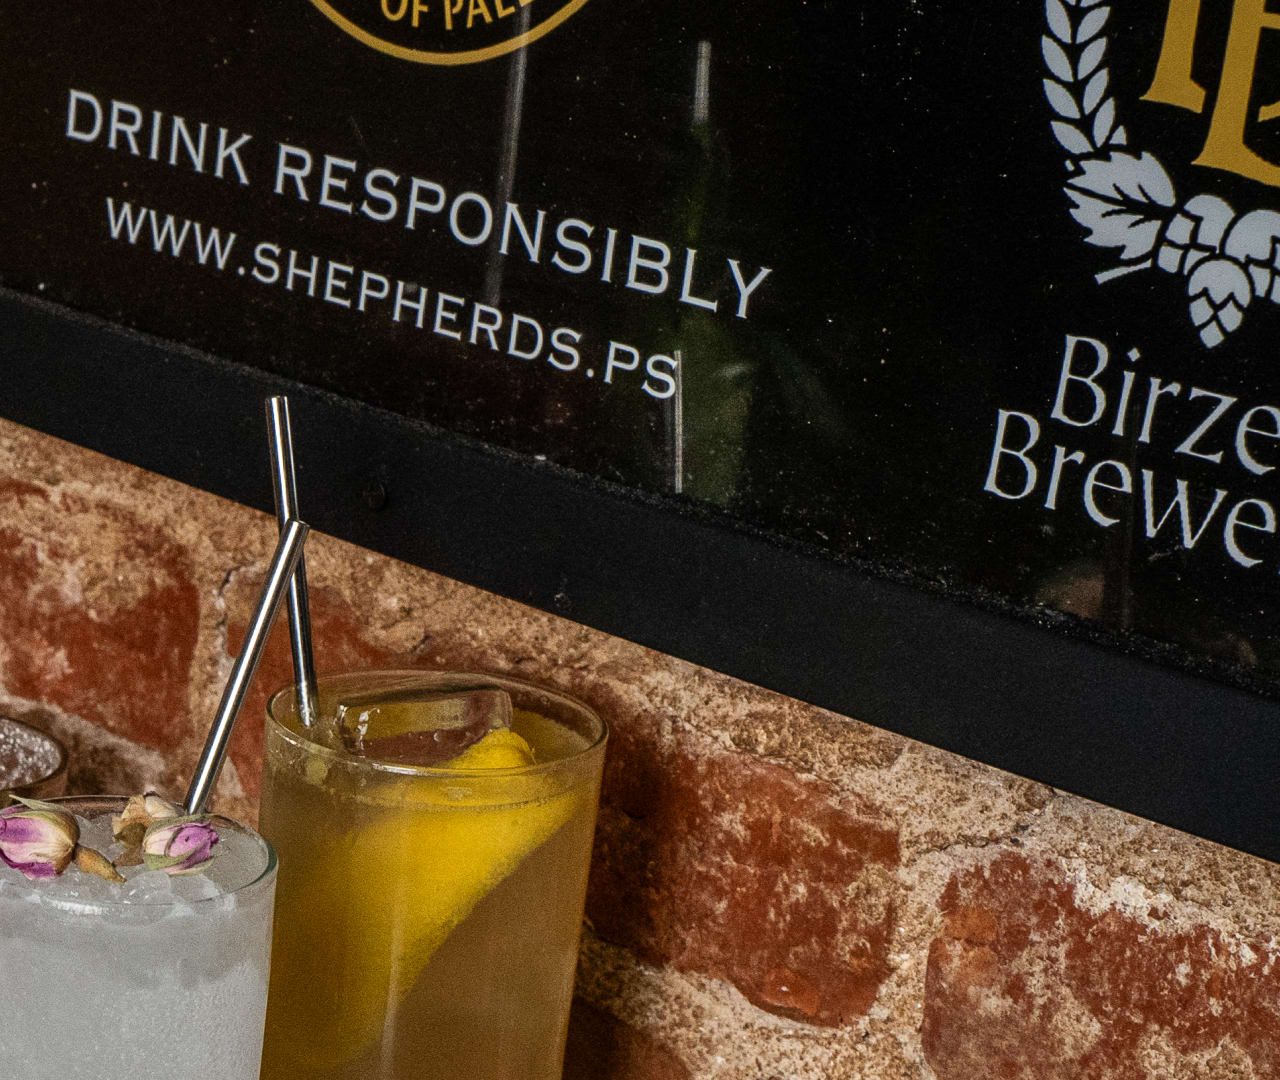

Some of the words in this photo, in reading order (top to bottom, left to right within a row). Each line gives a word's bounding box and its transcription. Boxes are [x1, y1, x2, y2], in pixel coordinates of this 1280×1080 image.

[443, 0, 532, 31] PAL
[66, 88, 253, 186] DRINK
[274, 143, 773, 319] RESPONSIBLY
[106, 197, 679, 400] WWW.SHEPHERDS.PS
[1050, 334, 1280, 475] Birze
[983, 408, 1277, 569] Brewe
